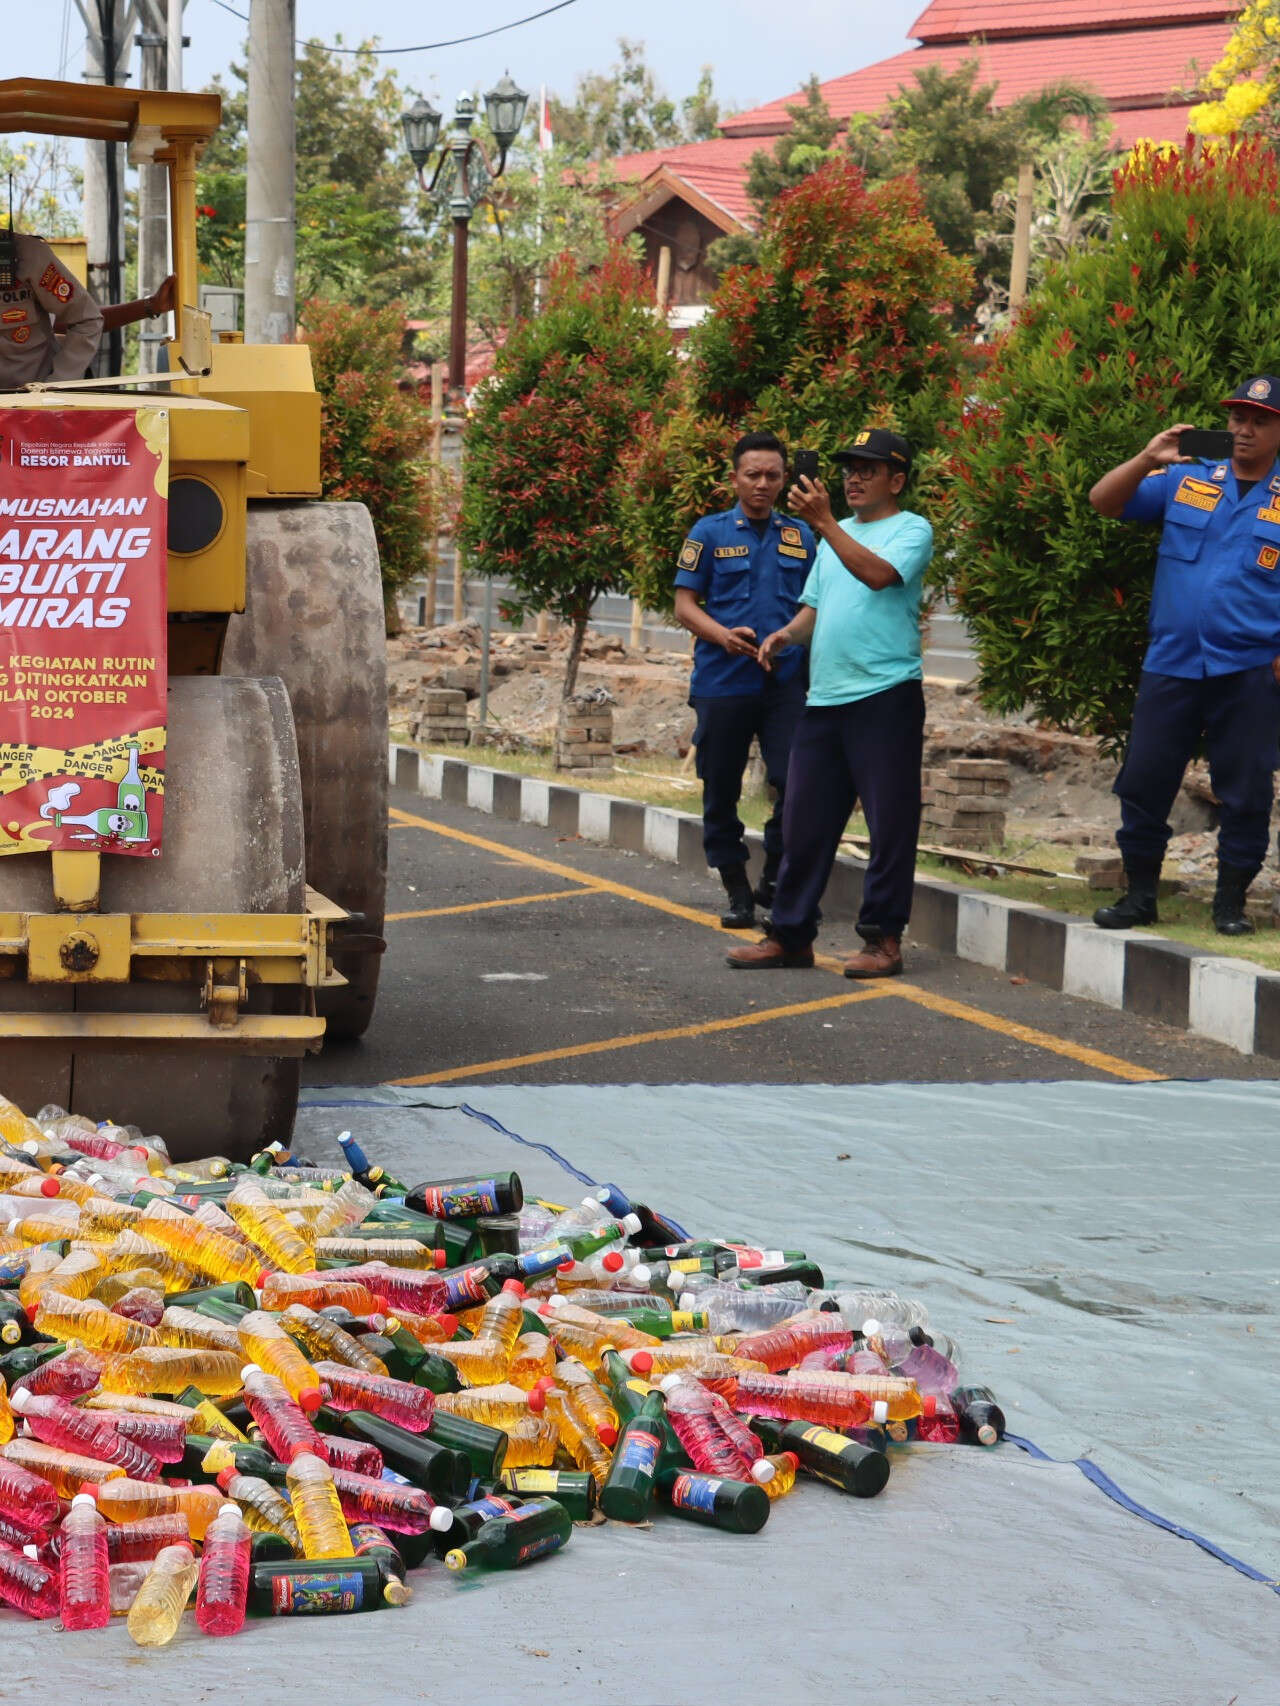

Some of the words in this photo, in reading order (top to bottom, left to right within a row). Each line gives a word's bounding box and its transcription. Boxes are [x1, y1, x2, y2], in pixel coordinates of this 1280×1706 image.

[21, 455, 69, 466] RESOR
[73, 455, 131, 467] BANTUL
[9, 655, 97, 670] KEGIATAN
[103, 657, 156, 671] RUTIN
[14, 671, 147, 688] DITINGKATKAN
[44, 690, 128, 704] OKTOBER
[30, 705, 75, 720] 2024
[93, 740, 138, 757] DANG
[64, 759, 113, 774] DANGER
